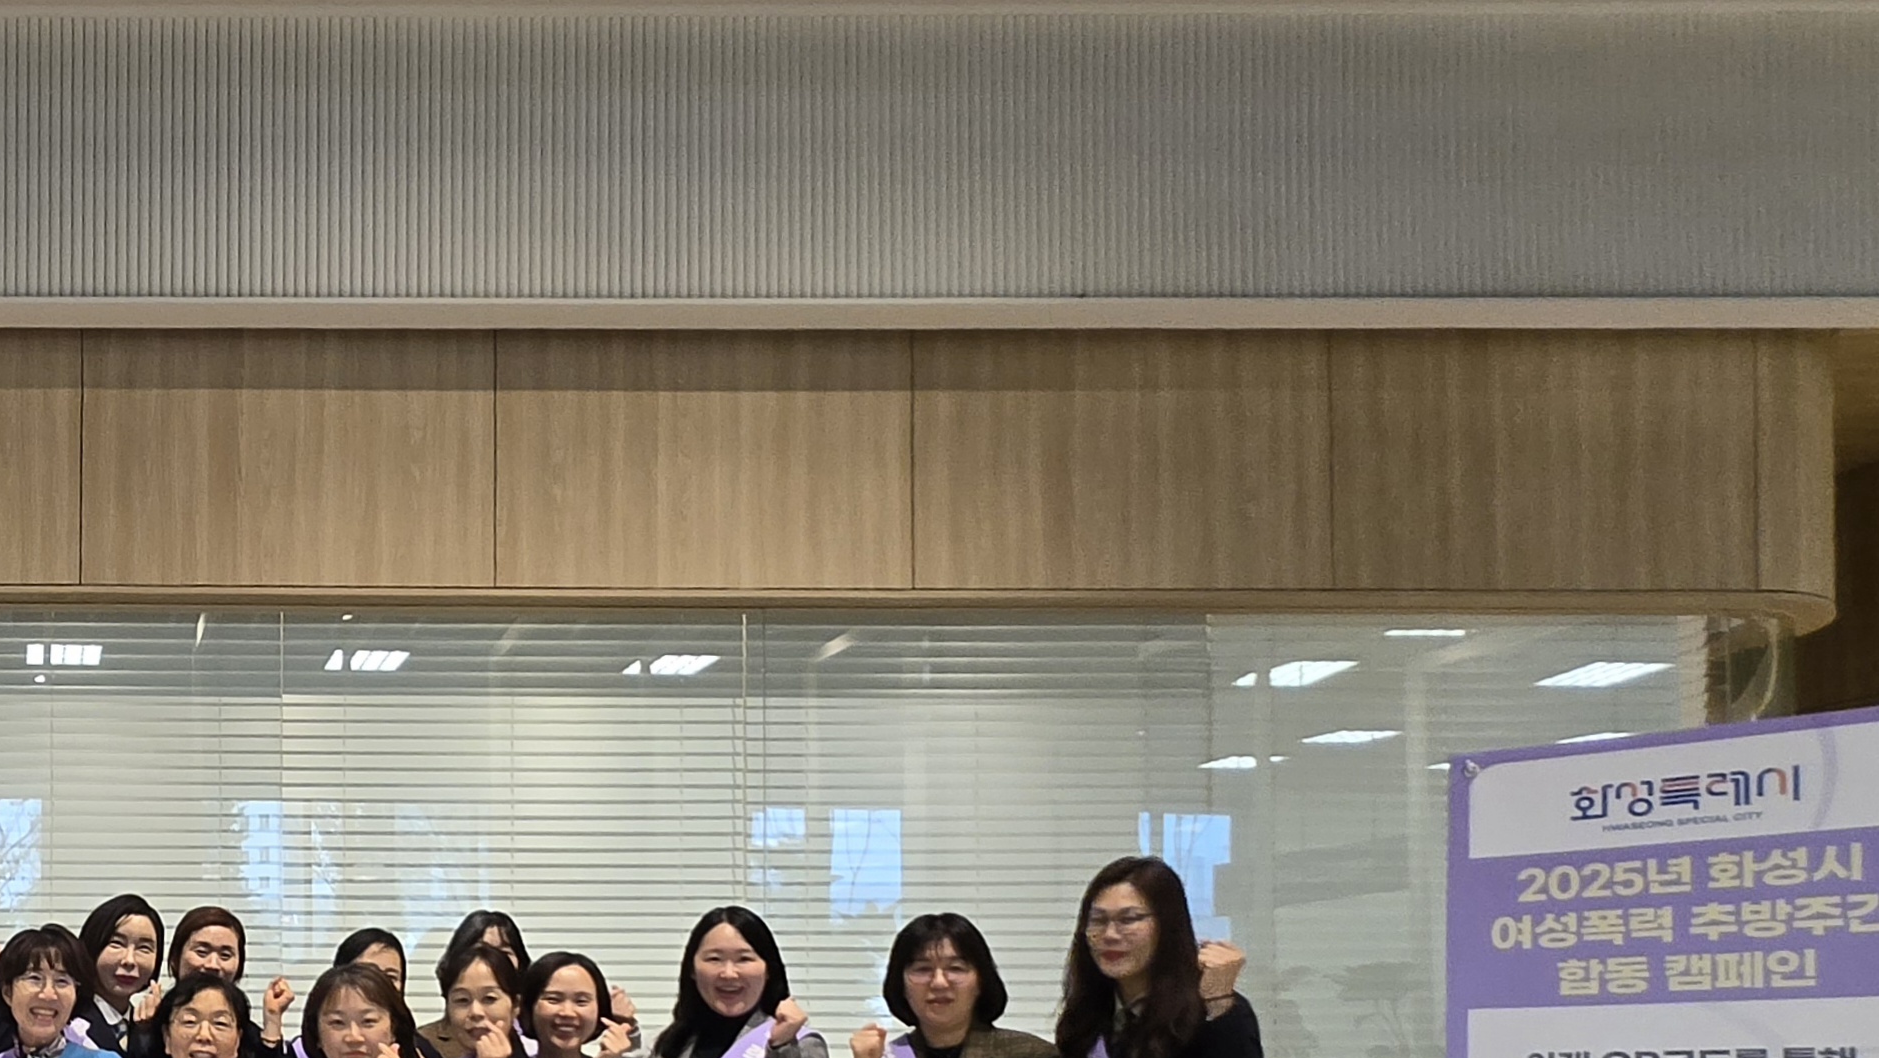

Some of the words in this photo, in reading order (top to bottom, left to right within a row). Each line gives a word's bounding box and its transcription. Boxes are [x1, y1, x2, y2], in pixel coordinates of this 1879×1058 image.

[1569, 764, 1801, 822] 화성특례시
[1601, 818, 1674, 833] HWASEONG
[1676, 814, 1728, 828] SPECIAL
[1732, 810, 1763, 823] CITY
[1516, 855, 1692, 903] 2025년
[1707, 842, 1864, 889] 화성시
[1491, 905, 1674, 951] 여성폭력
[1556, 955, 1650, 996] 합동
[1664, 948, 1818, 991] 캠페인
